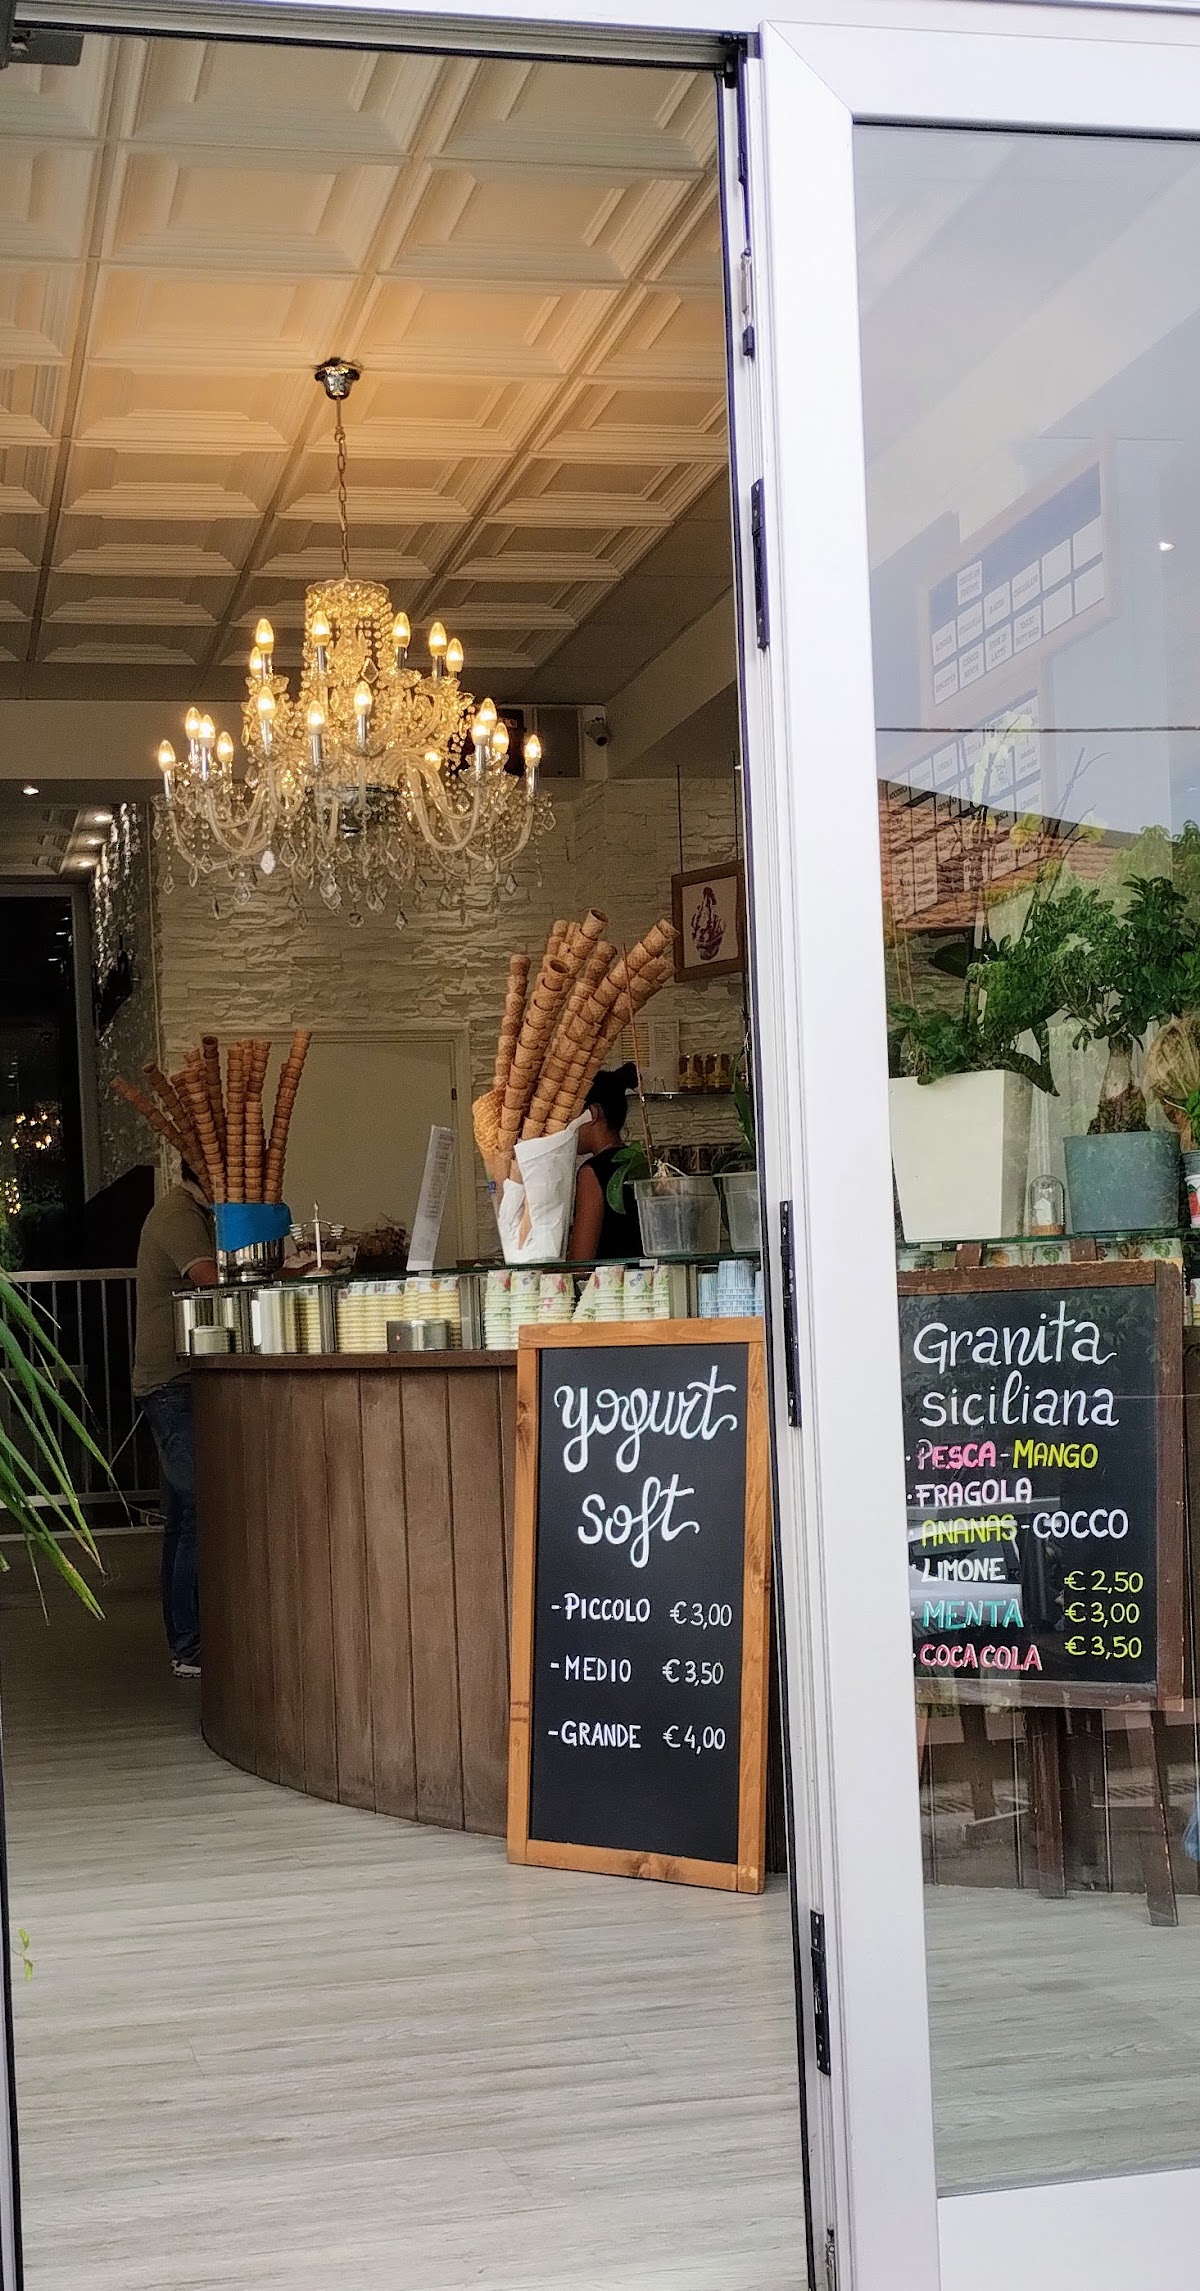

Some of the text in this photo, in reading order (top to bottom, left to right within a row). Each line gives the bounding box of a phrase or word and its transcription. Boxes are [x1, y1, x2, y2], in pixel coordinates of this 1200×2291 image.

[913, 1300, 1118, 1374] Granita
[919, 1370, 1119, 1427] siciliana
[915, 1477, 1032, 1507] FRAGOLA
[921, 1558, 1006, 1582] LIMONE
[923, 1599, 1024, 1629] MENTA
